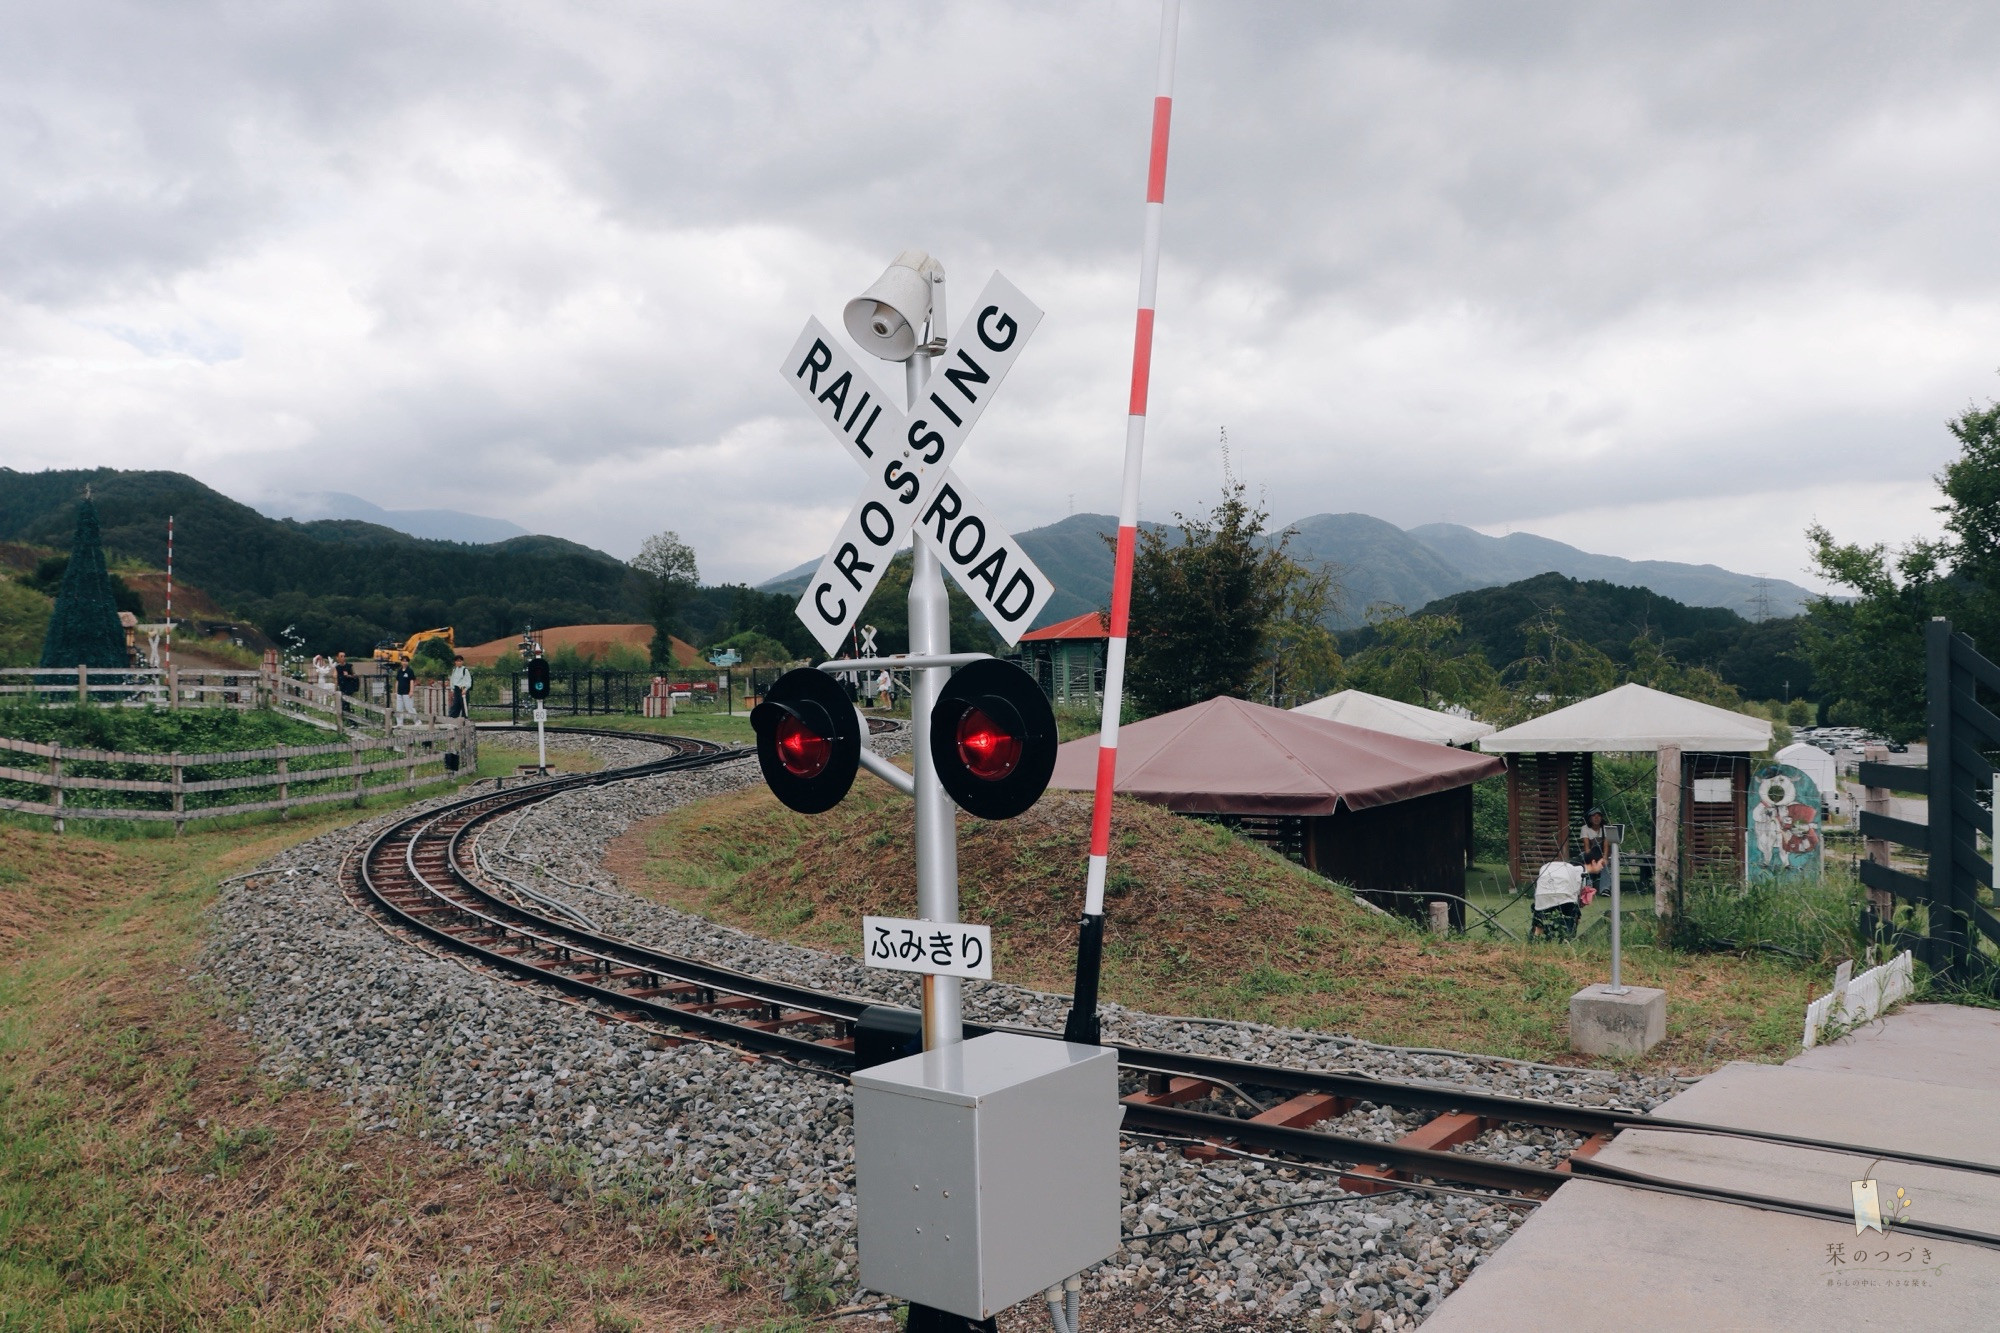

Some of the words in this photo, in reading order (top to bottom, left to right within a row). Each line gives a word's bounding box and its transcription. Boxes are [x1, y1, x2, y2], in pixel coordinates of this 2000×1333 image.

[797, 337, 882, 459] RAIL
[922, 483, 1035, 623] ROAD
[815, 305, 1018, 626] CROSSING
[872, 926, 983, 968] ふみきり
